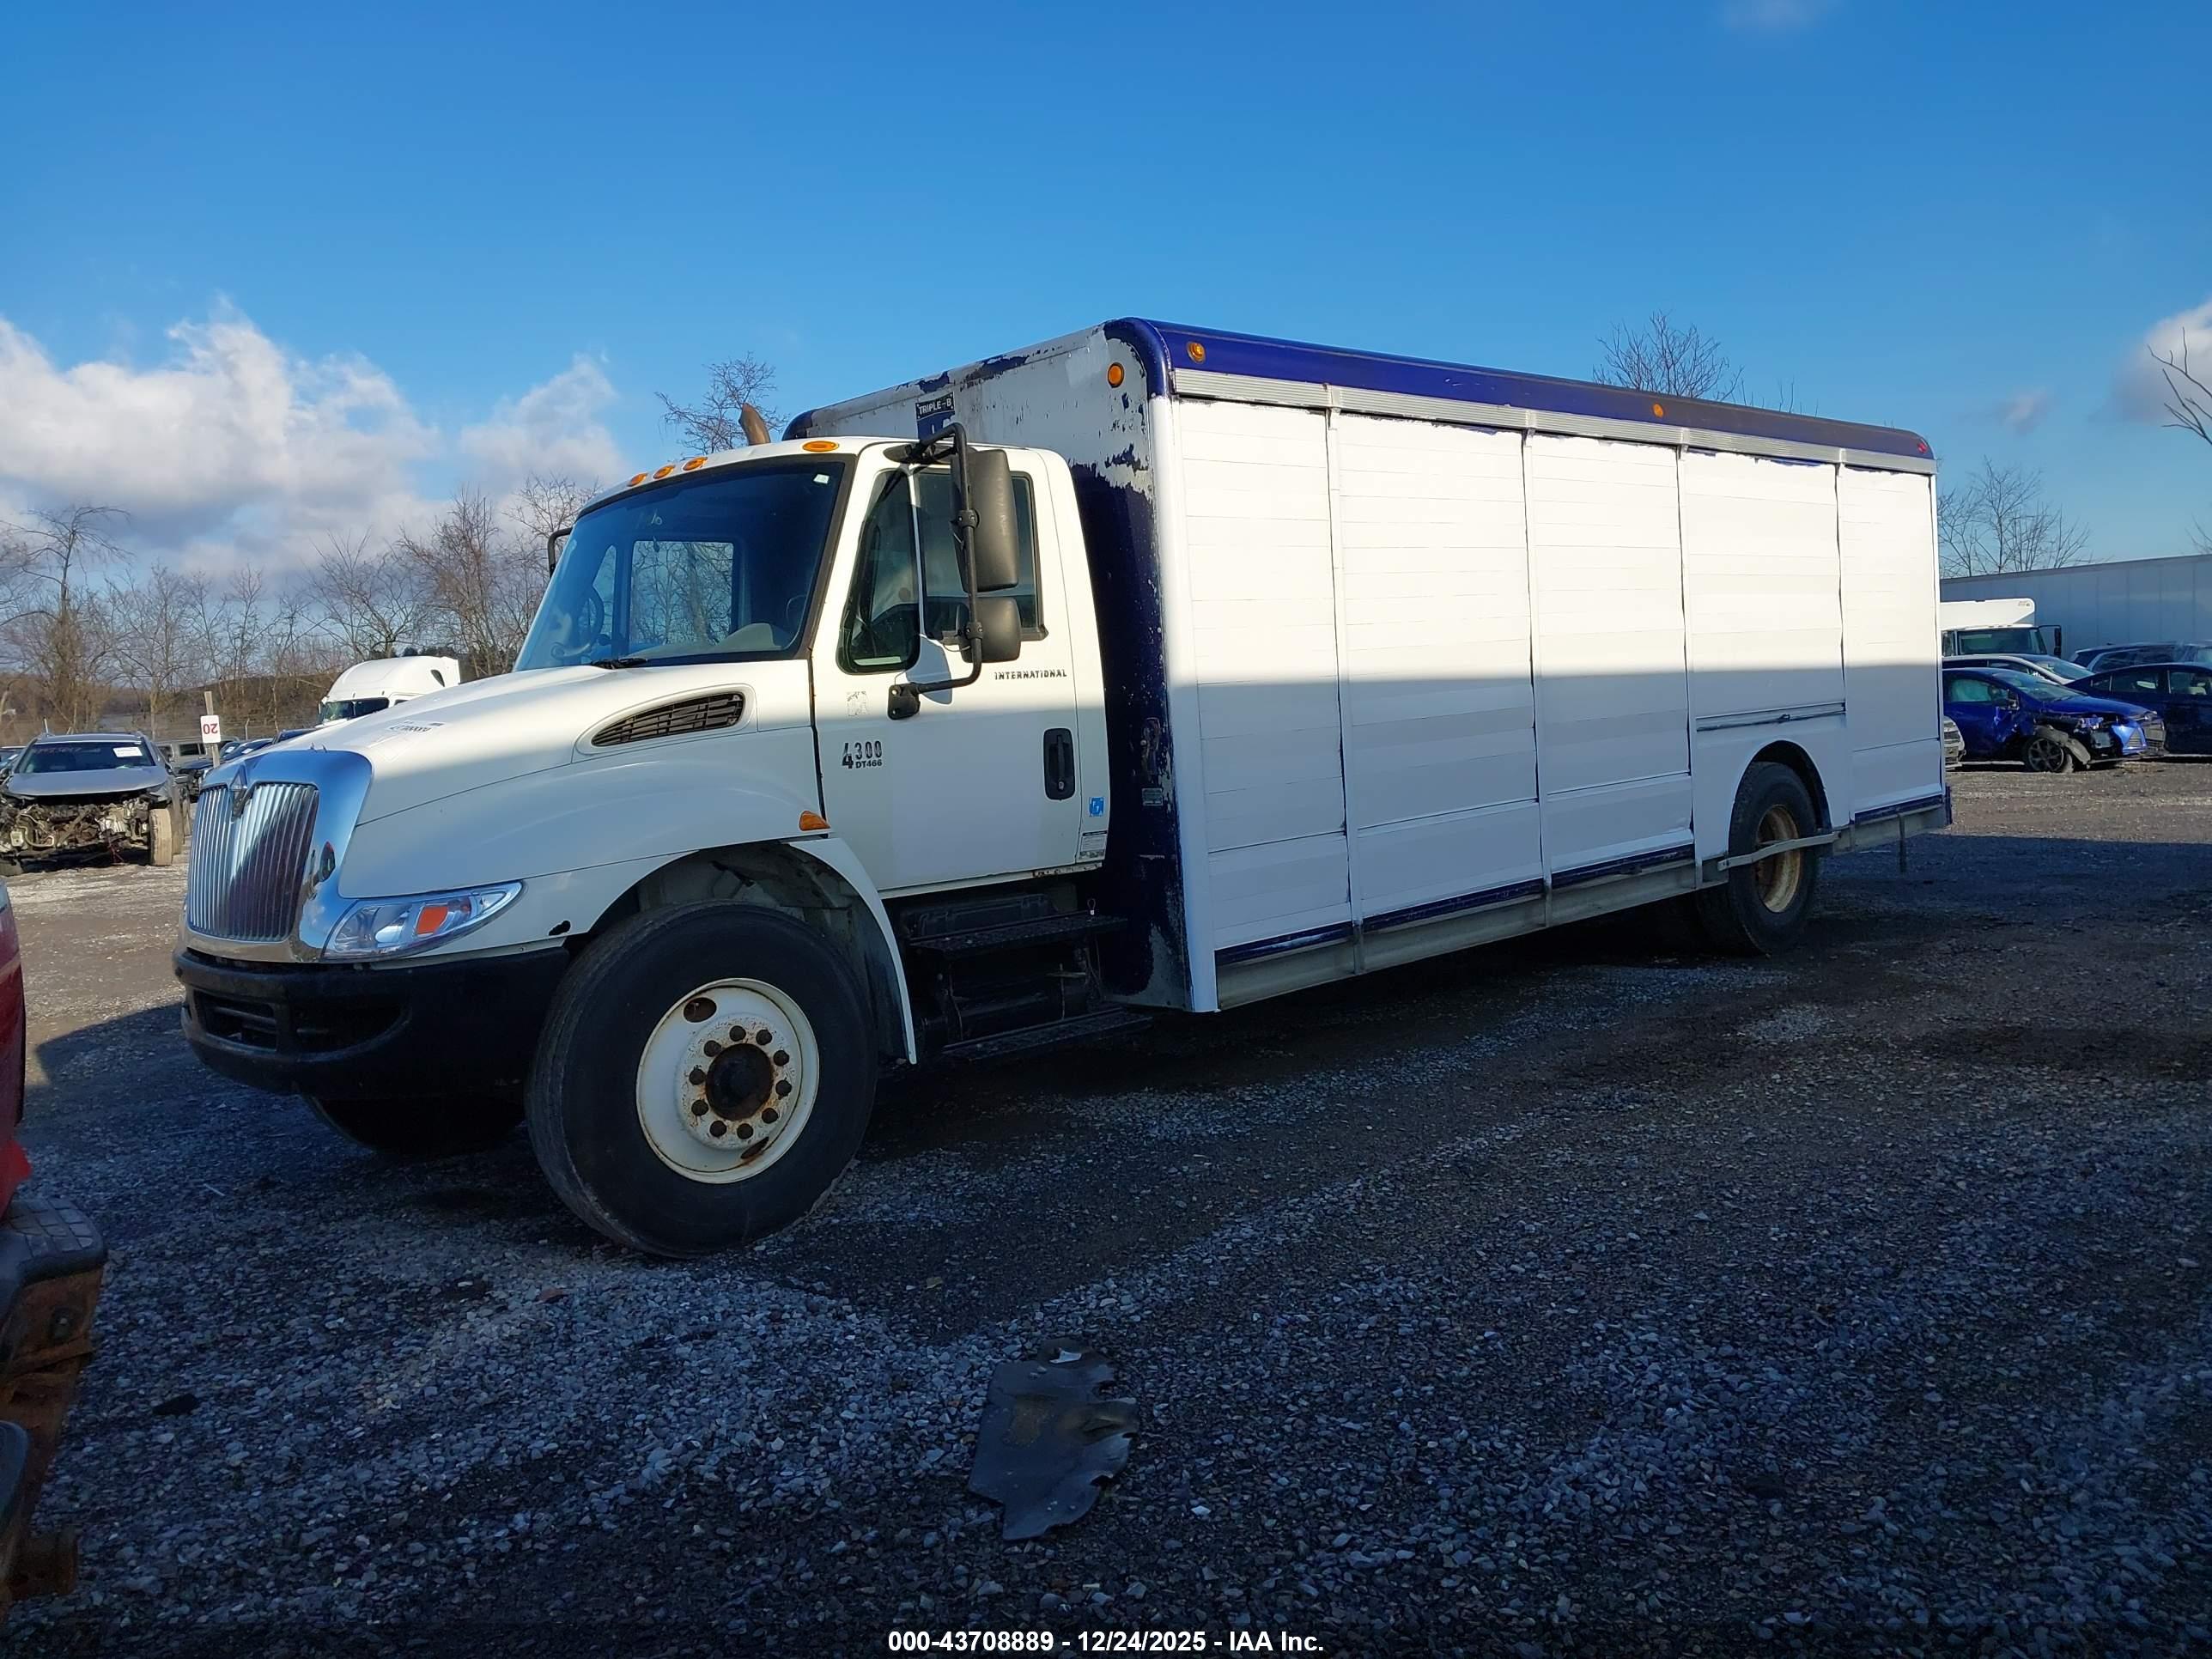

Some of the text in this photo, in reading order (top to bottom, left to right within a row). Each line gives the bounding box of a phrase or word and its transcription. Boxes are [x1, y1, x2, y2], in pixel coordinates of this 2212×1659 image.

[918, 398, 952, 415] TRIPLE-B
[994, 669, 1067, 680] INTERNATIONAL
[842, 740, 883, 769] 4300
[855, 759, 883, 769] DT466
